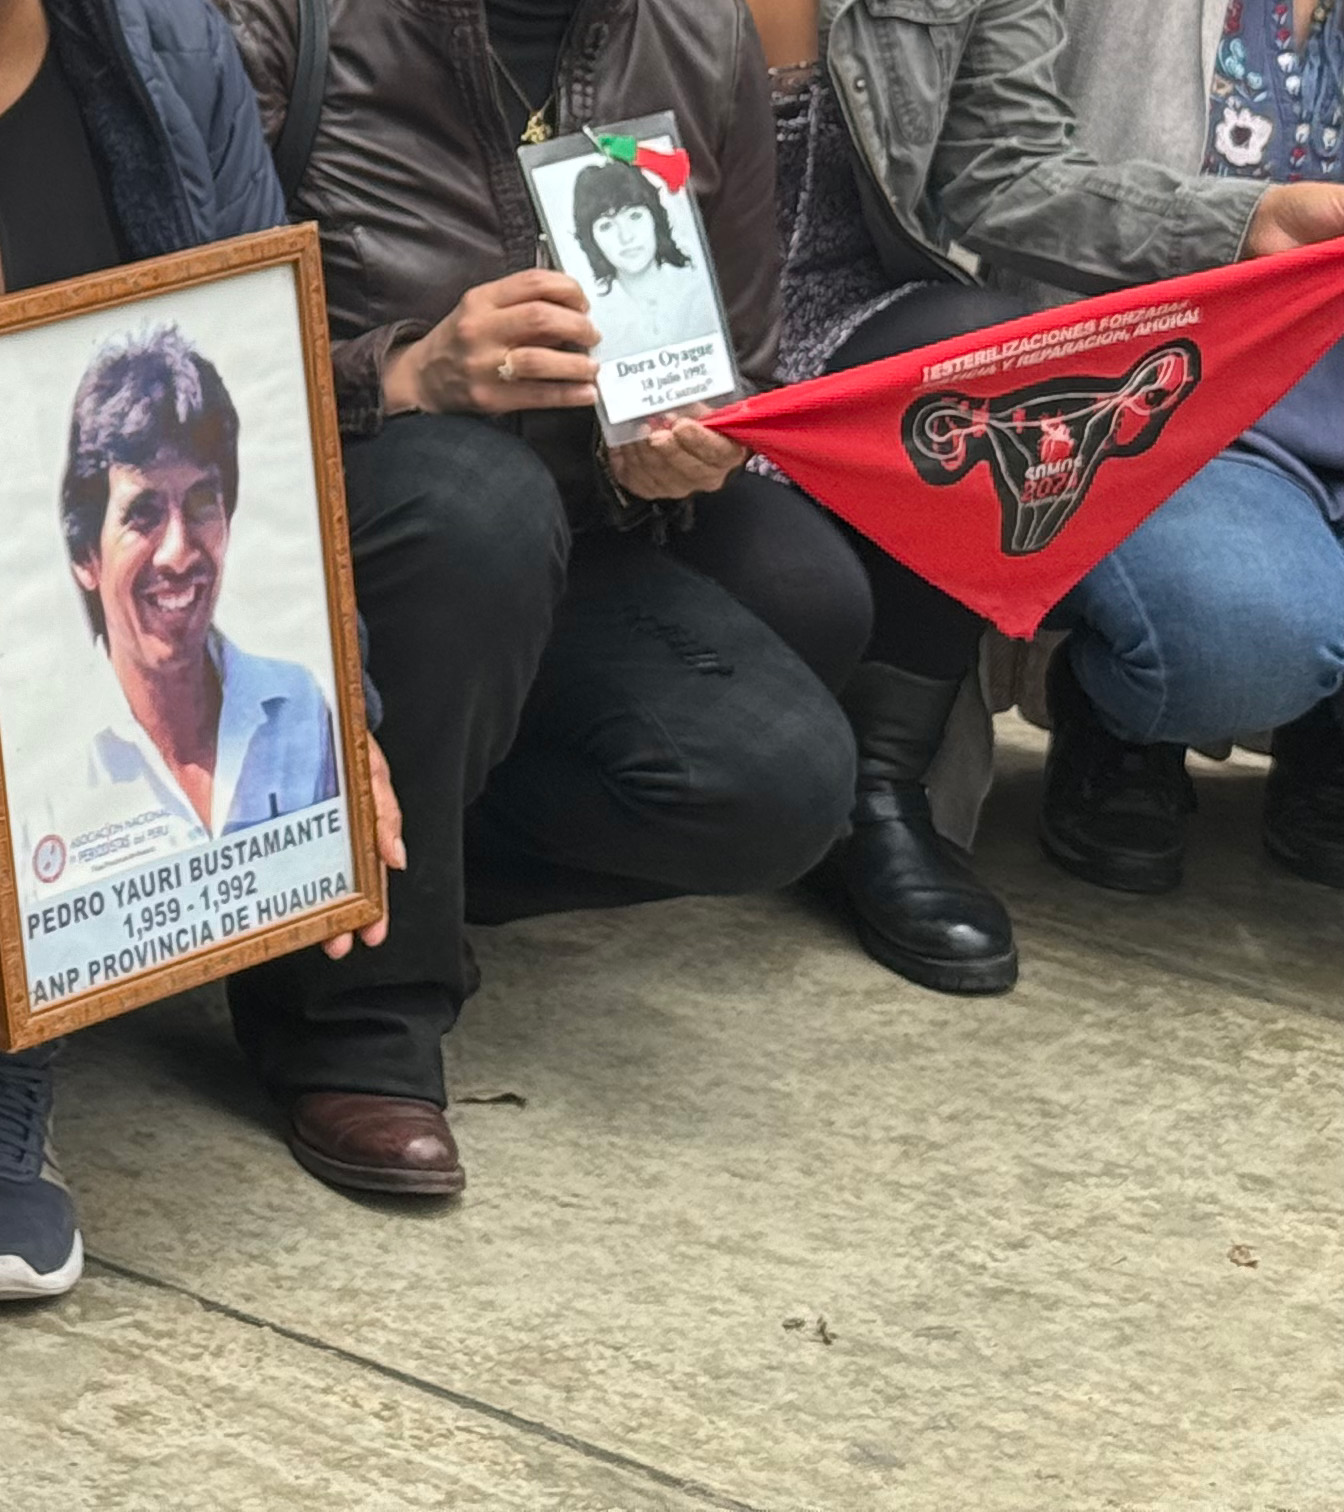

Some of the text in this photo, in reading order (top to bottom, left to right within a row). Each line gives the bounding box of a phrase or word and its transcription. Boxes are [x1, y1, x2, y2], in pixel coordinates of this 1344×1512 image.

[616, 342, 714, 378] Dora Oyague
[27, 890, 106, 940] PEDRO
[112, 863, 182, 910] YAURI
[189, 807, 342, 883] BUSTAMANTE
[122, 897, 181, 940] 1,959
[200, 870, 258, 913] 1,992
[32, 871, 348, 1006] ANP PROVINCIA DE HUAURA
